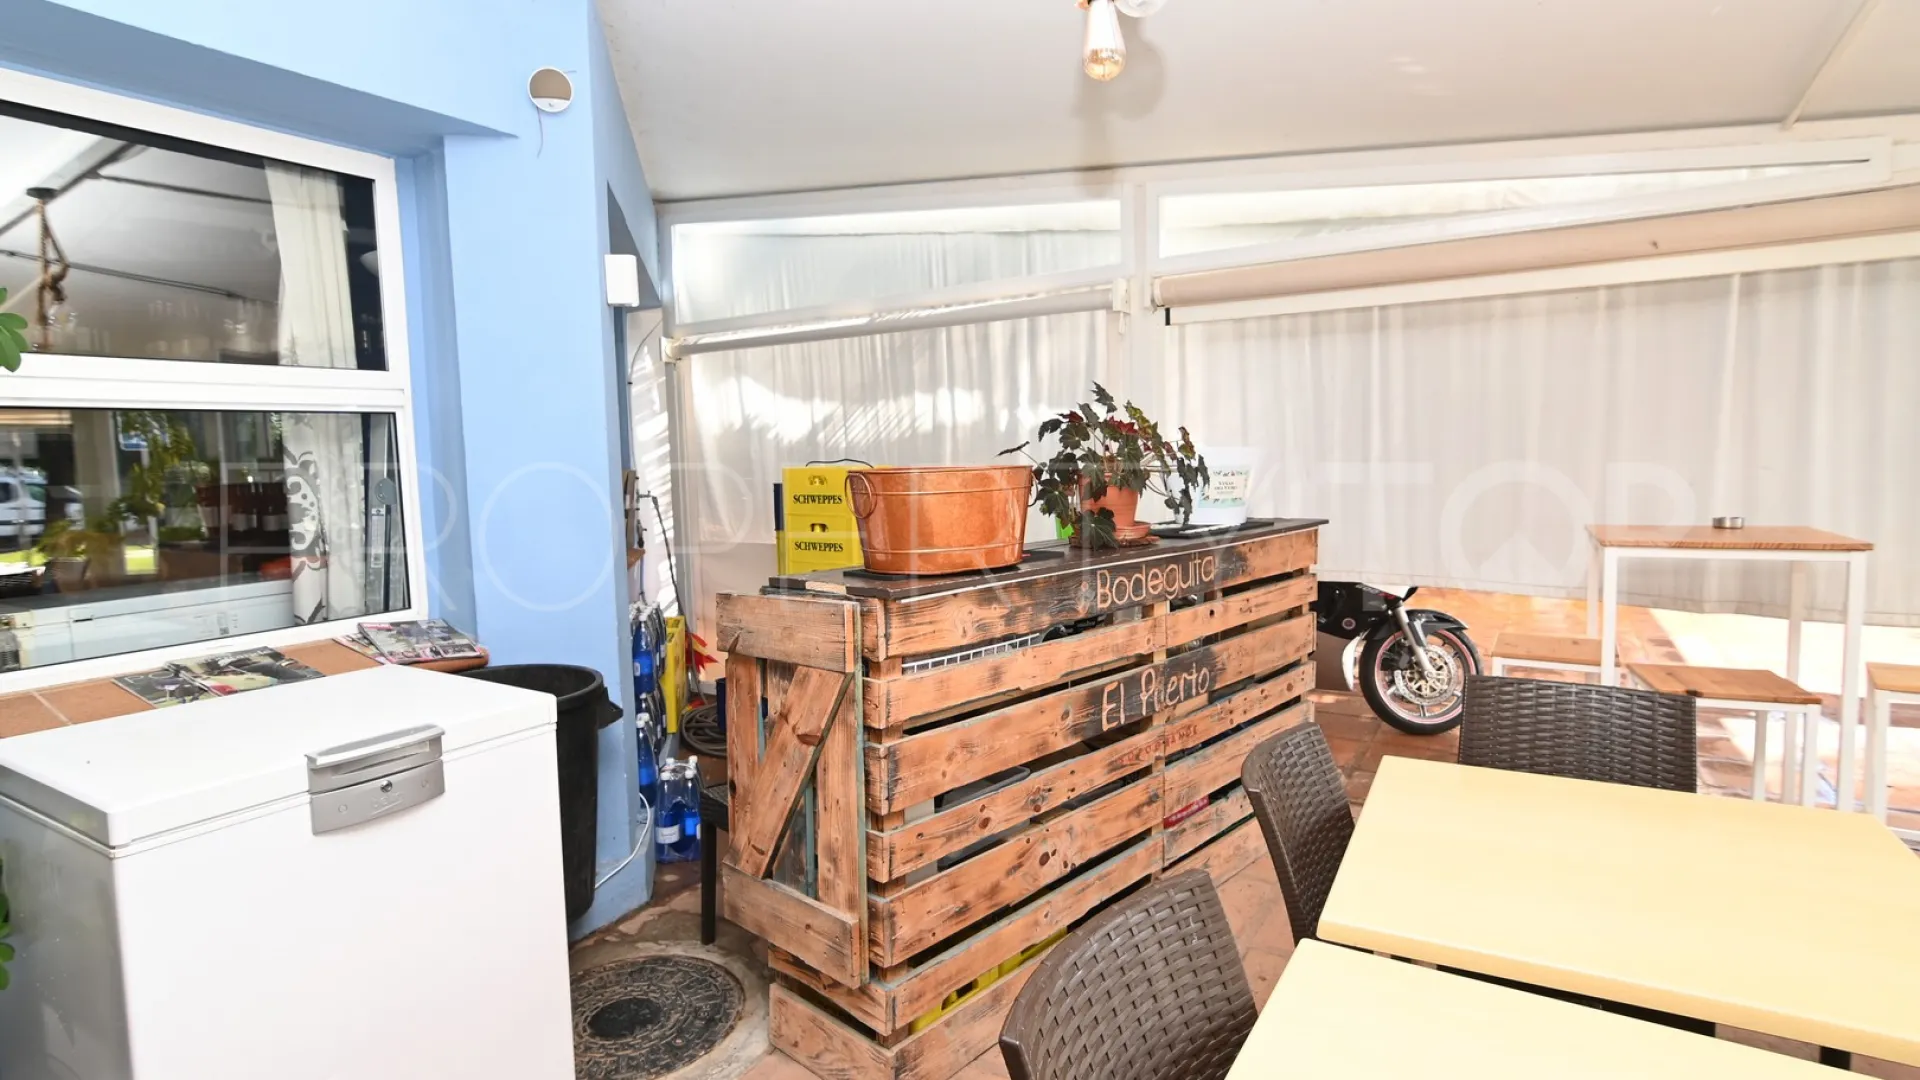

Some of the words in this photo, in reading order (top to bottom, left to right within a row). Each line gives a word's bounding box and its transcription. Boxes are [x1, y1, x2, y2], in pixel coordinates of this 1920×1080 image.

[793, 494, 842, 505] SCHWEPPES
[794, 541, 844, 553] SCHWEPPES
[1096, 552, 1216, 609] Bodeguita
[1101, 682, 1126, 732] El
[1139, 662, 1210, 717] Puerto
